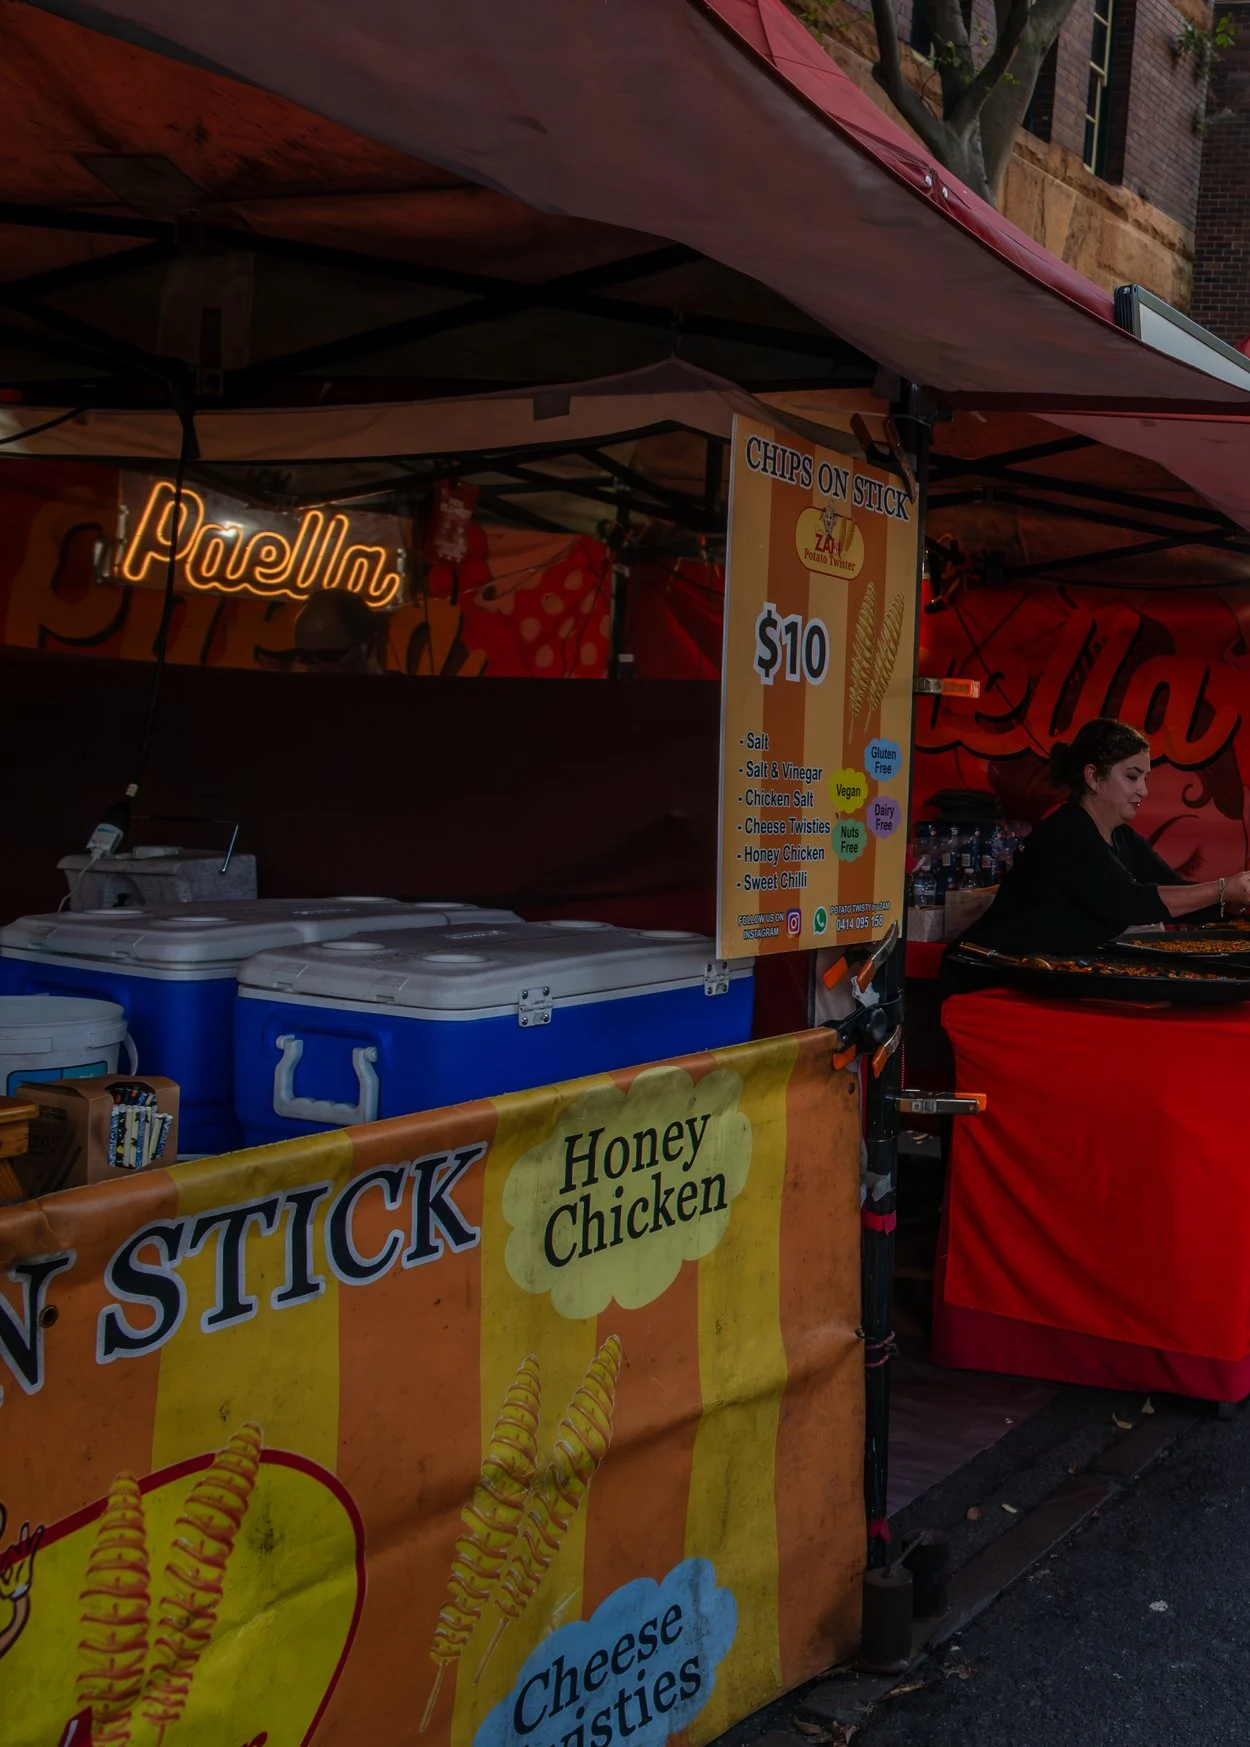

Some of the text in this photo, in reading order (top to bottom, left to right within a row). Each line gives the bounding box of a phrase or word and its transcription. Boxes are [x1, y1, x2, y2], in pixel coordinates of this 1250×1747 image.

[746, 436, 911, 520] CHIPS ON STICK
[121, 481, 401, 607] Paella
[803, 548, 856, 571] Potato Twister
[755, 605, 828, 682] $10
[746, 732, 769, 751] Salt
[871, 745, 897, 760] Gluten
[746, 761, 823, 783] Salt & Vinegar
[874, 762, 892, 775] Free
[745, 789, 814, 808] Chicken Salt
[836, 783, 861, 799] Vegan
[874, 803, 895, 819] Dairy
[744, 817, 831, 834] Cheese Twisties
[841, 825, 859, 839] Nuts
[875, 819, 893, 832] Free
[744, 845, 825, 866] Honey Chicken
[840, 841, 859, 854] Free
[743, 871, 808, 891] Sweet Chilli
[738, 912, 785, 926] FOLLOW US ON
[829, 905, 852, 916] POTATO
[836, 914, 884, 931] 0414 095 158
[743, 926, 779, 940] INSTAGRAM
[559, 1114, 711, 1194] Honey
[544, 1171, 728, 1267] Chicken
[100, 1144, 484, 1361] STICK
[513, 1604, 683, 1735] Cheese
